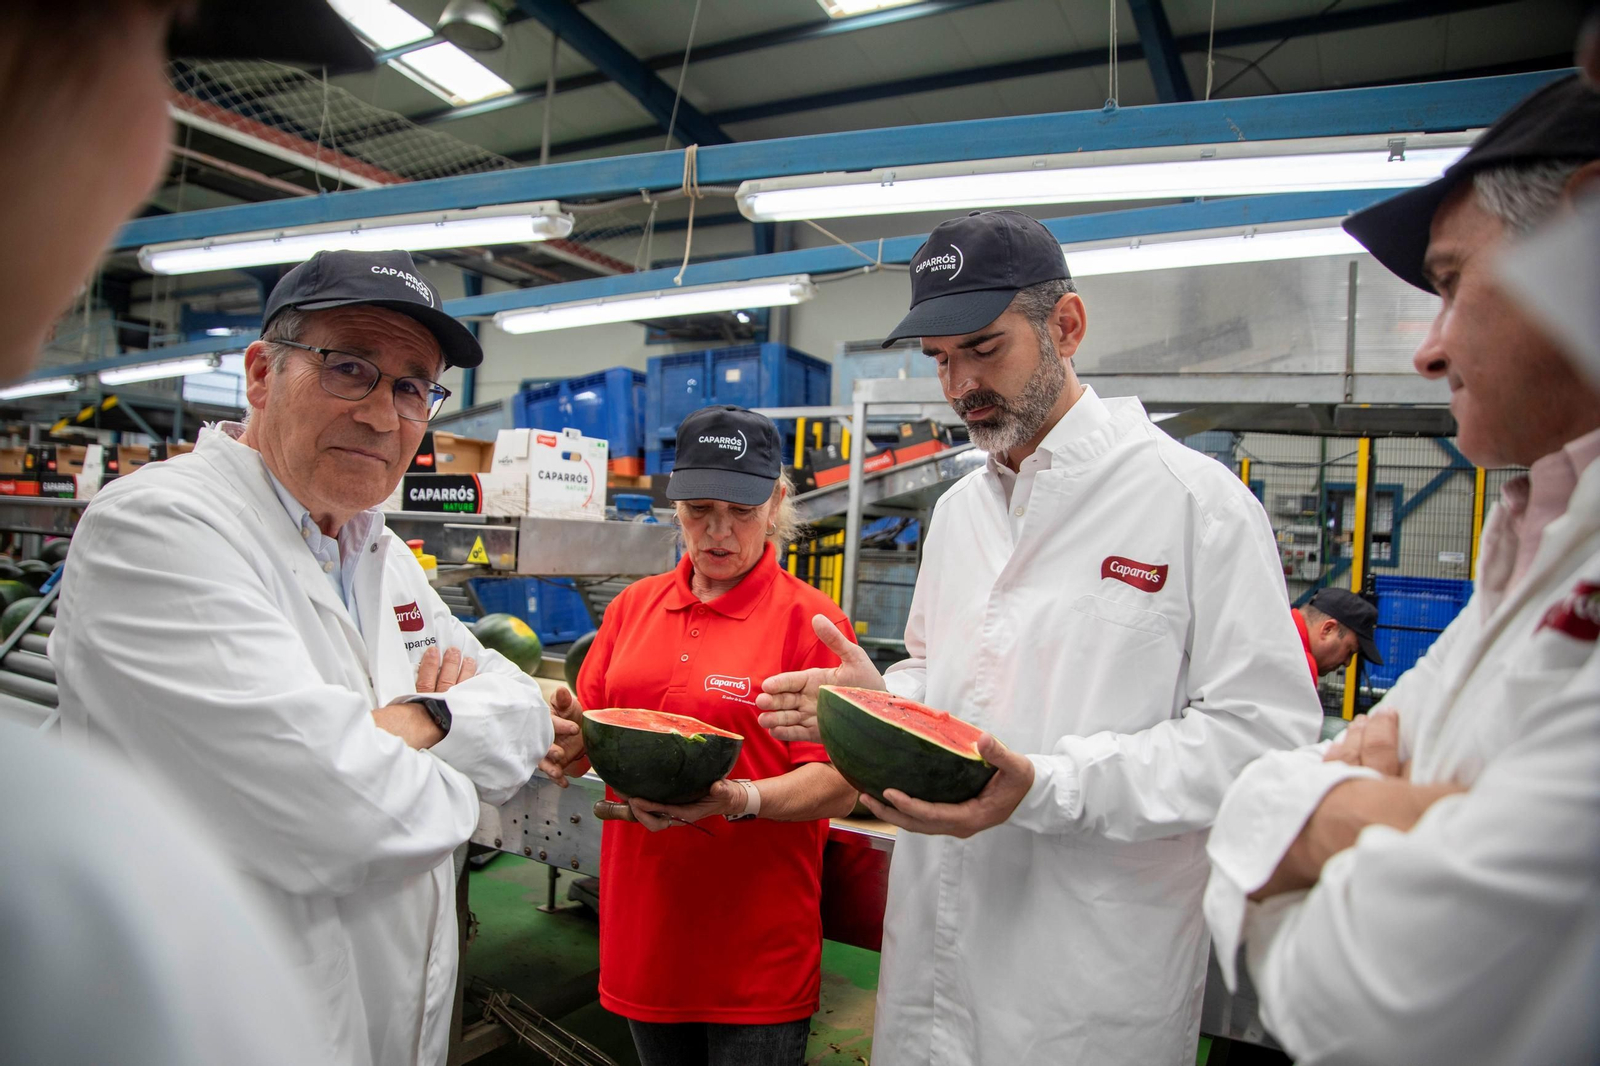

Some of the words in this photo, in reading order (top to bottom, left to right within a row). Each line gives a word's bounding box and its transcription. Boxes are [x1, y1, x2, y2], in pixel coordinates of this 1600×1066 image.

[916, 253, 957, 273] CAPARRÓS
[931, 264, 956, 272] NATURE
[371, 266, 429, 296] CAPARRÓS
[405, 281, 430, 302] NATURE
[698, 436, 742, 446] CAPARRÓS
[538, 470, 588, 484] CAPARRÓS
[409, 485, 475, 501] CAPARRÓS
[565, 484, 588, 492] NATURE
[443, 502, 474, 511] NATURE
[710, 678, 746, 690] Caparrós
